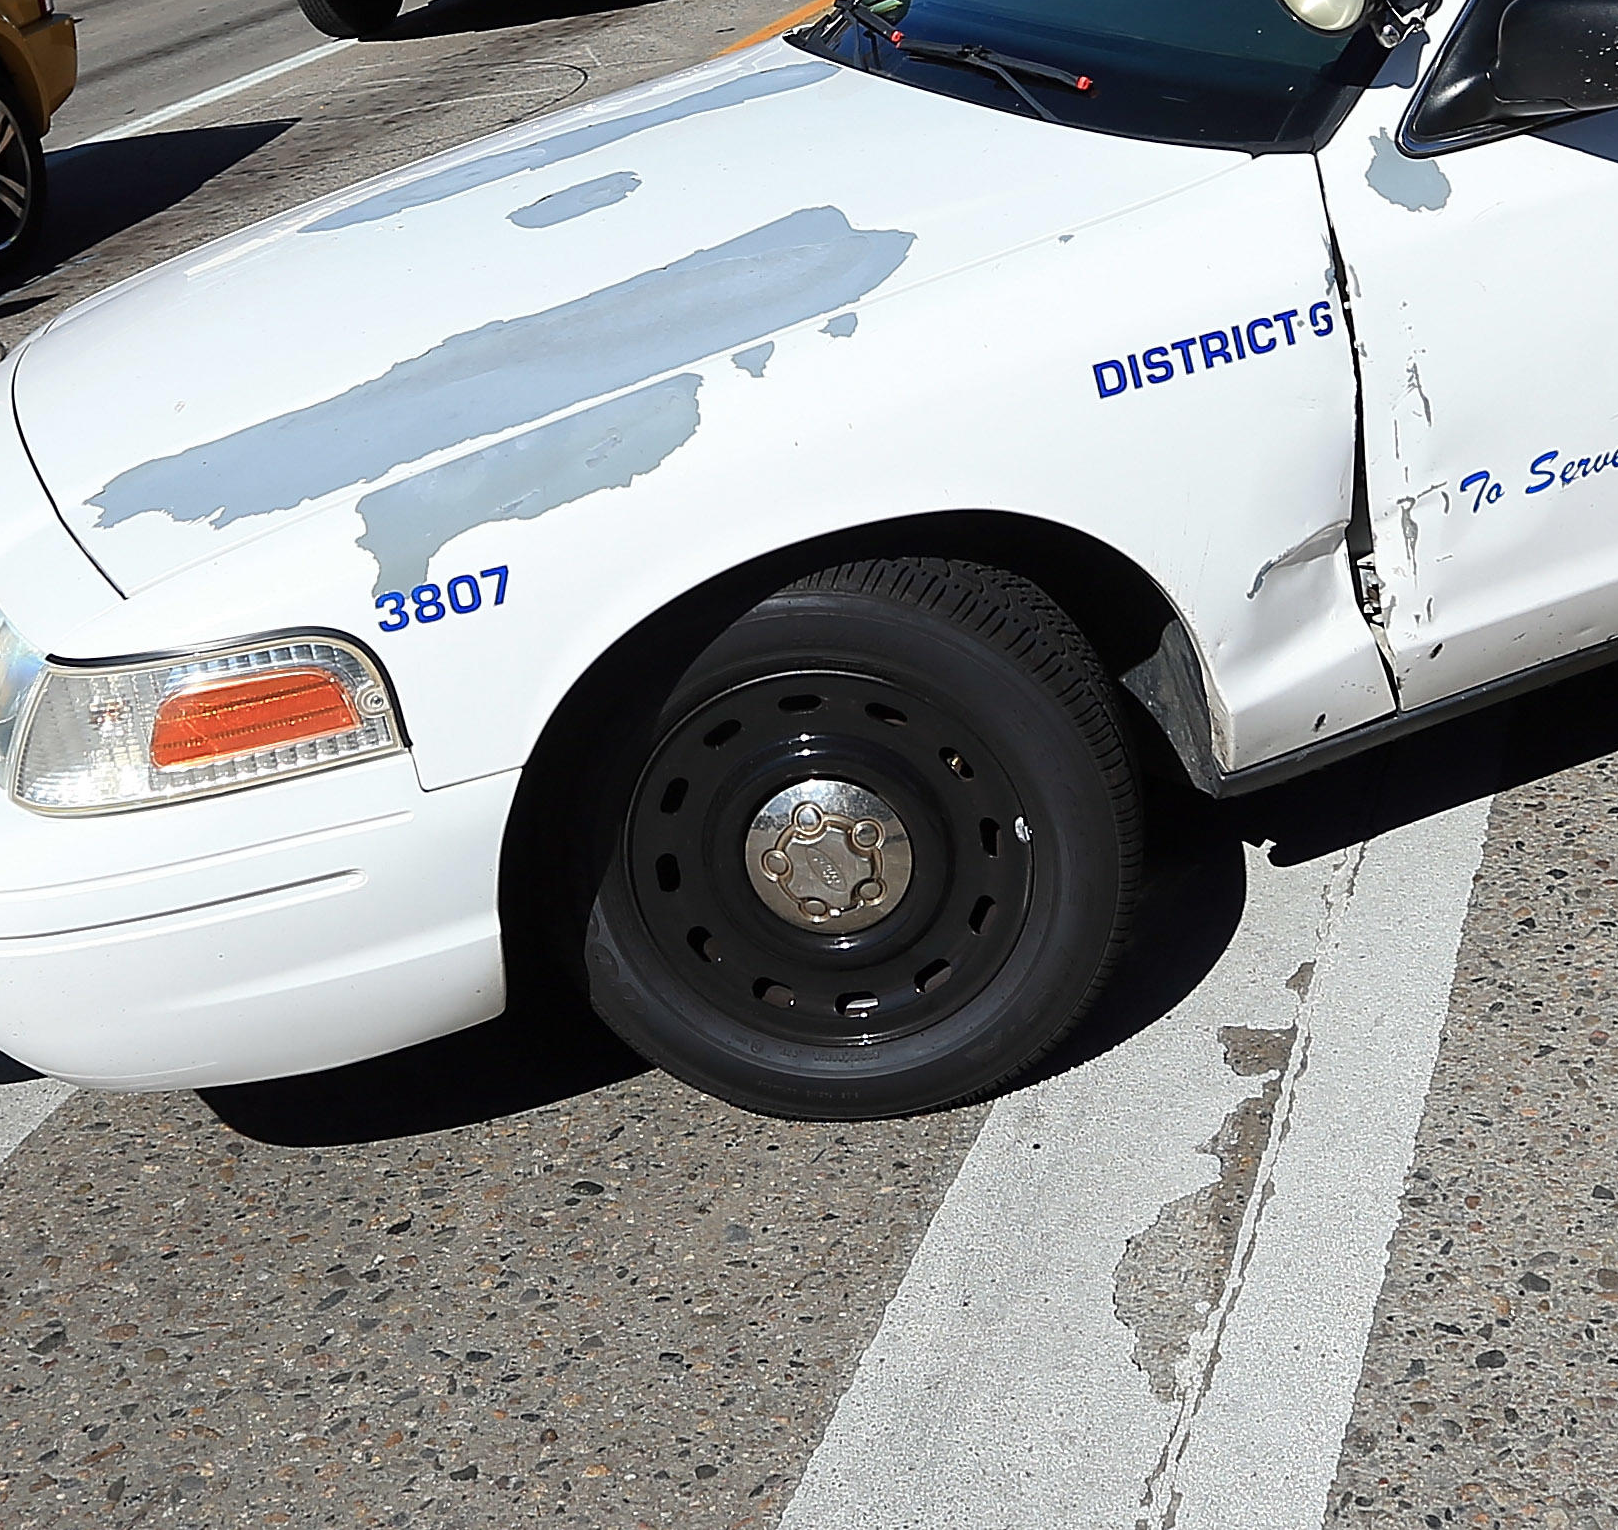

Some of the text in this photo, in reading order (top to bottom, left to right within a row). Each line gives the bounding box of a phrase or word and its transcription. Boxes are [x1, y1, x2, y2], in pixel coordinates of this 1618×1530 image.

[1092, 309, 1298, 399] DISTRICT
[1460, 470, 1505, 514] To
[375, 564, 509, 633] 3807
